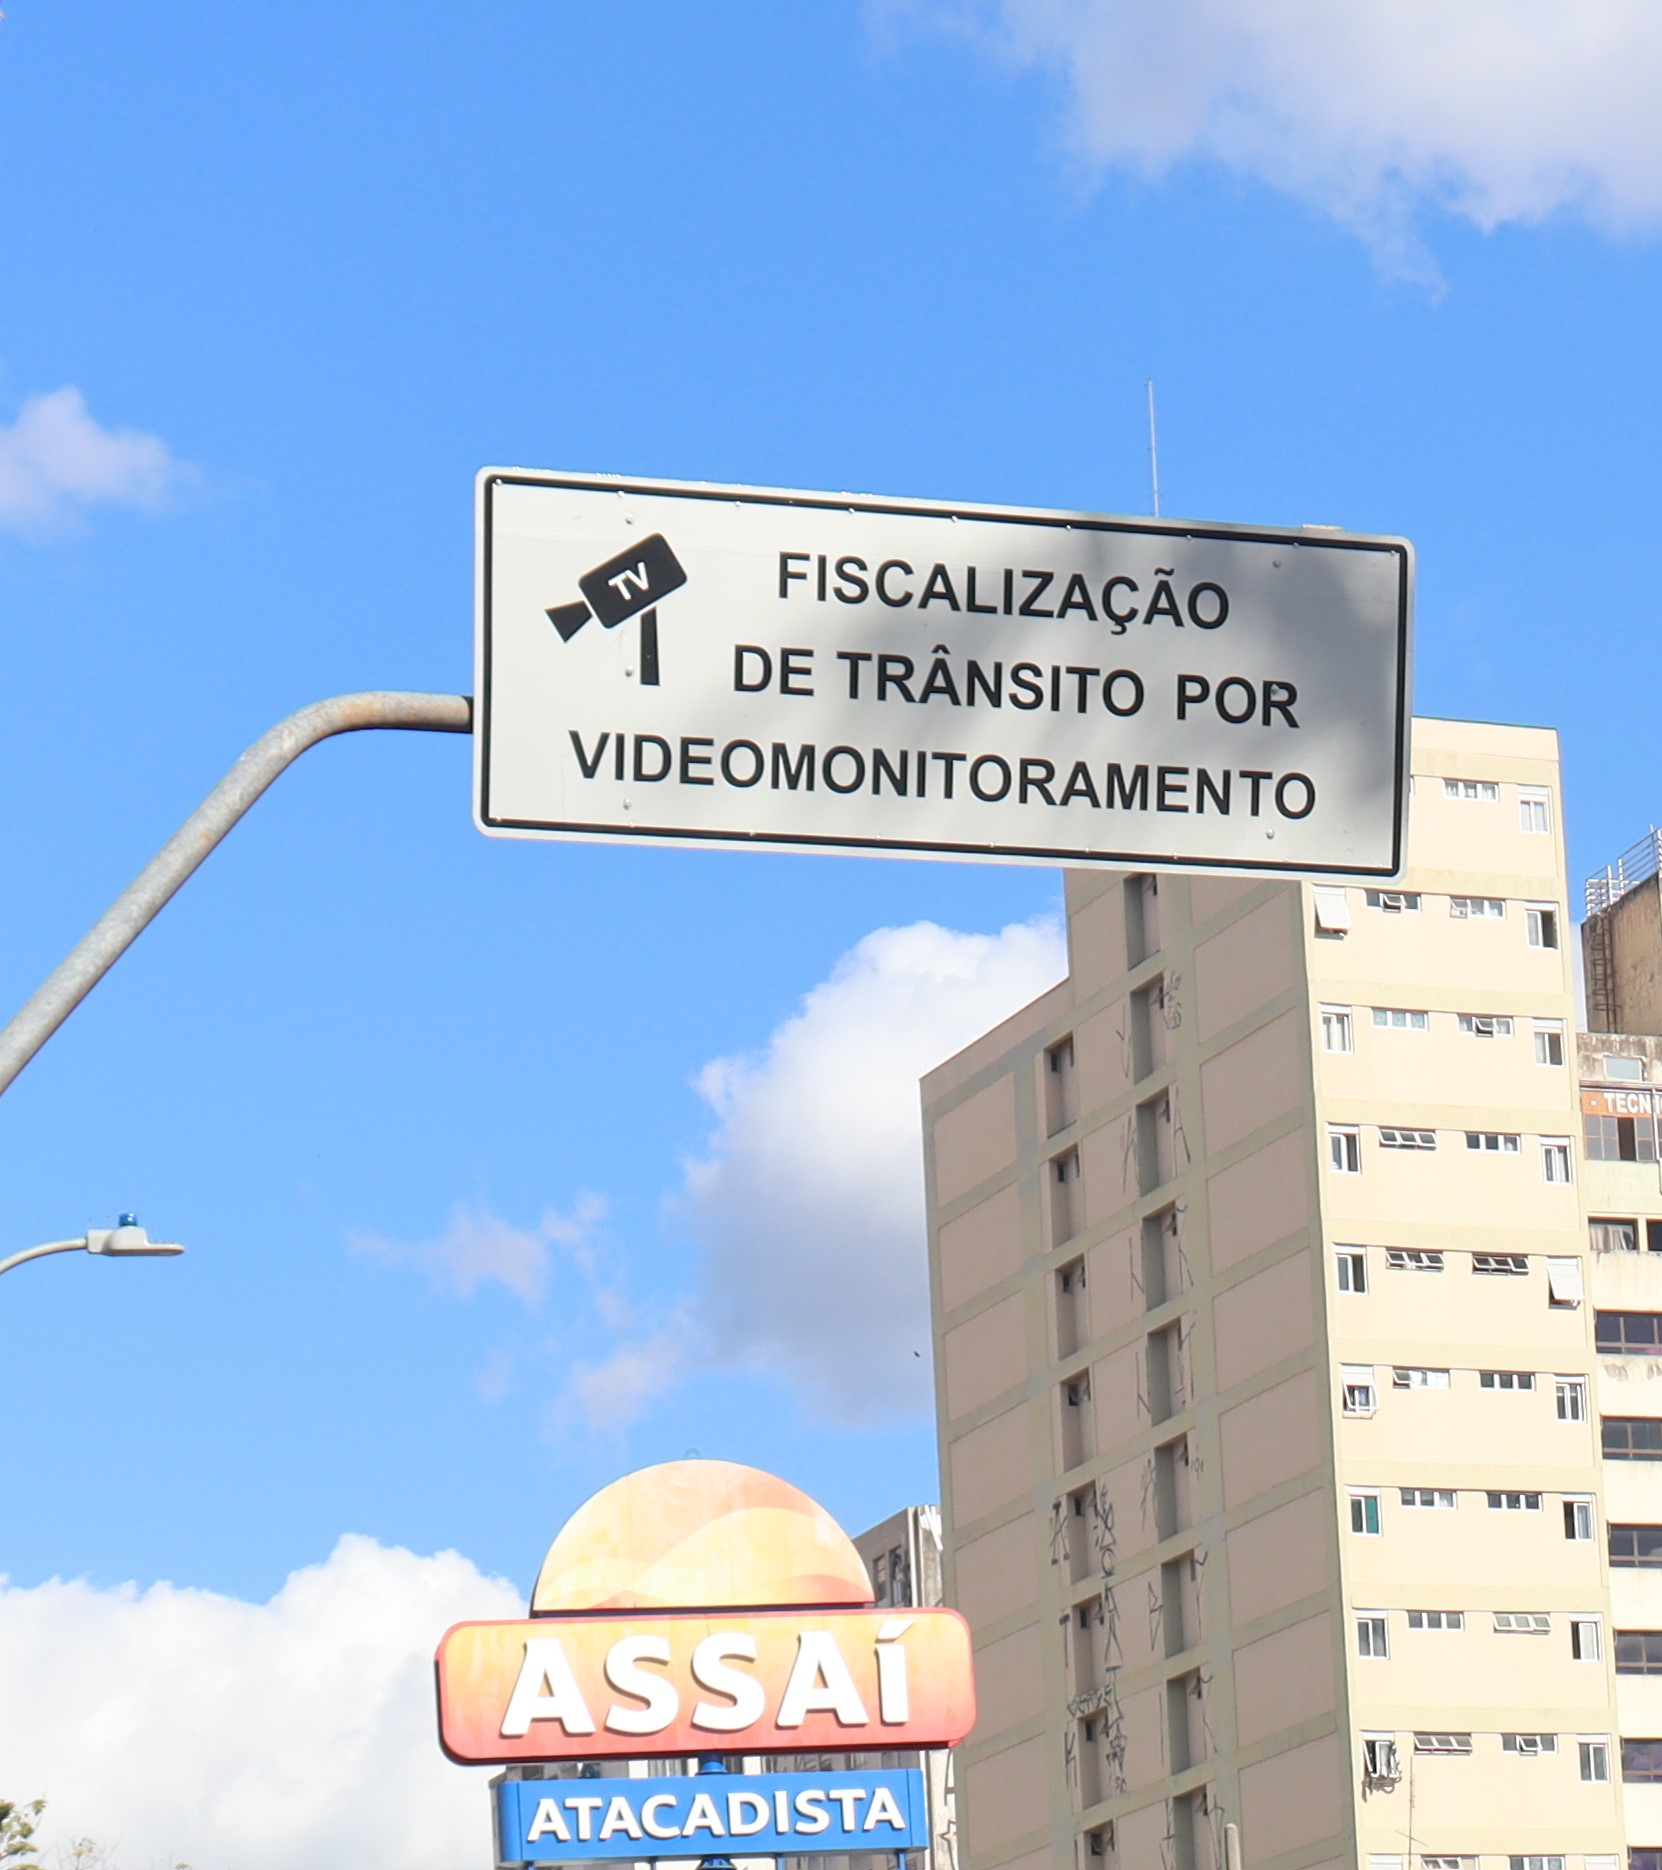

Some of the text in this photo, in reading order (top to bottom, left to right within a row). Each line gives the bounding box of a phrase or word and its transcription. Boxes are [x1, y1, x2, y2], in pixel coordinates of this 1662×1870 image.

[607, 561, 649, 601] TV
[778, 551, 1230, 634] FISCALIZAÇÃO
[733, 645, 1301, 729] DE TRÂNSITO POR
[568, 729, 1316, 820] VIDEOMONITORAMENTO
[526, 1786, 906, 1843] ATACADISTA
